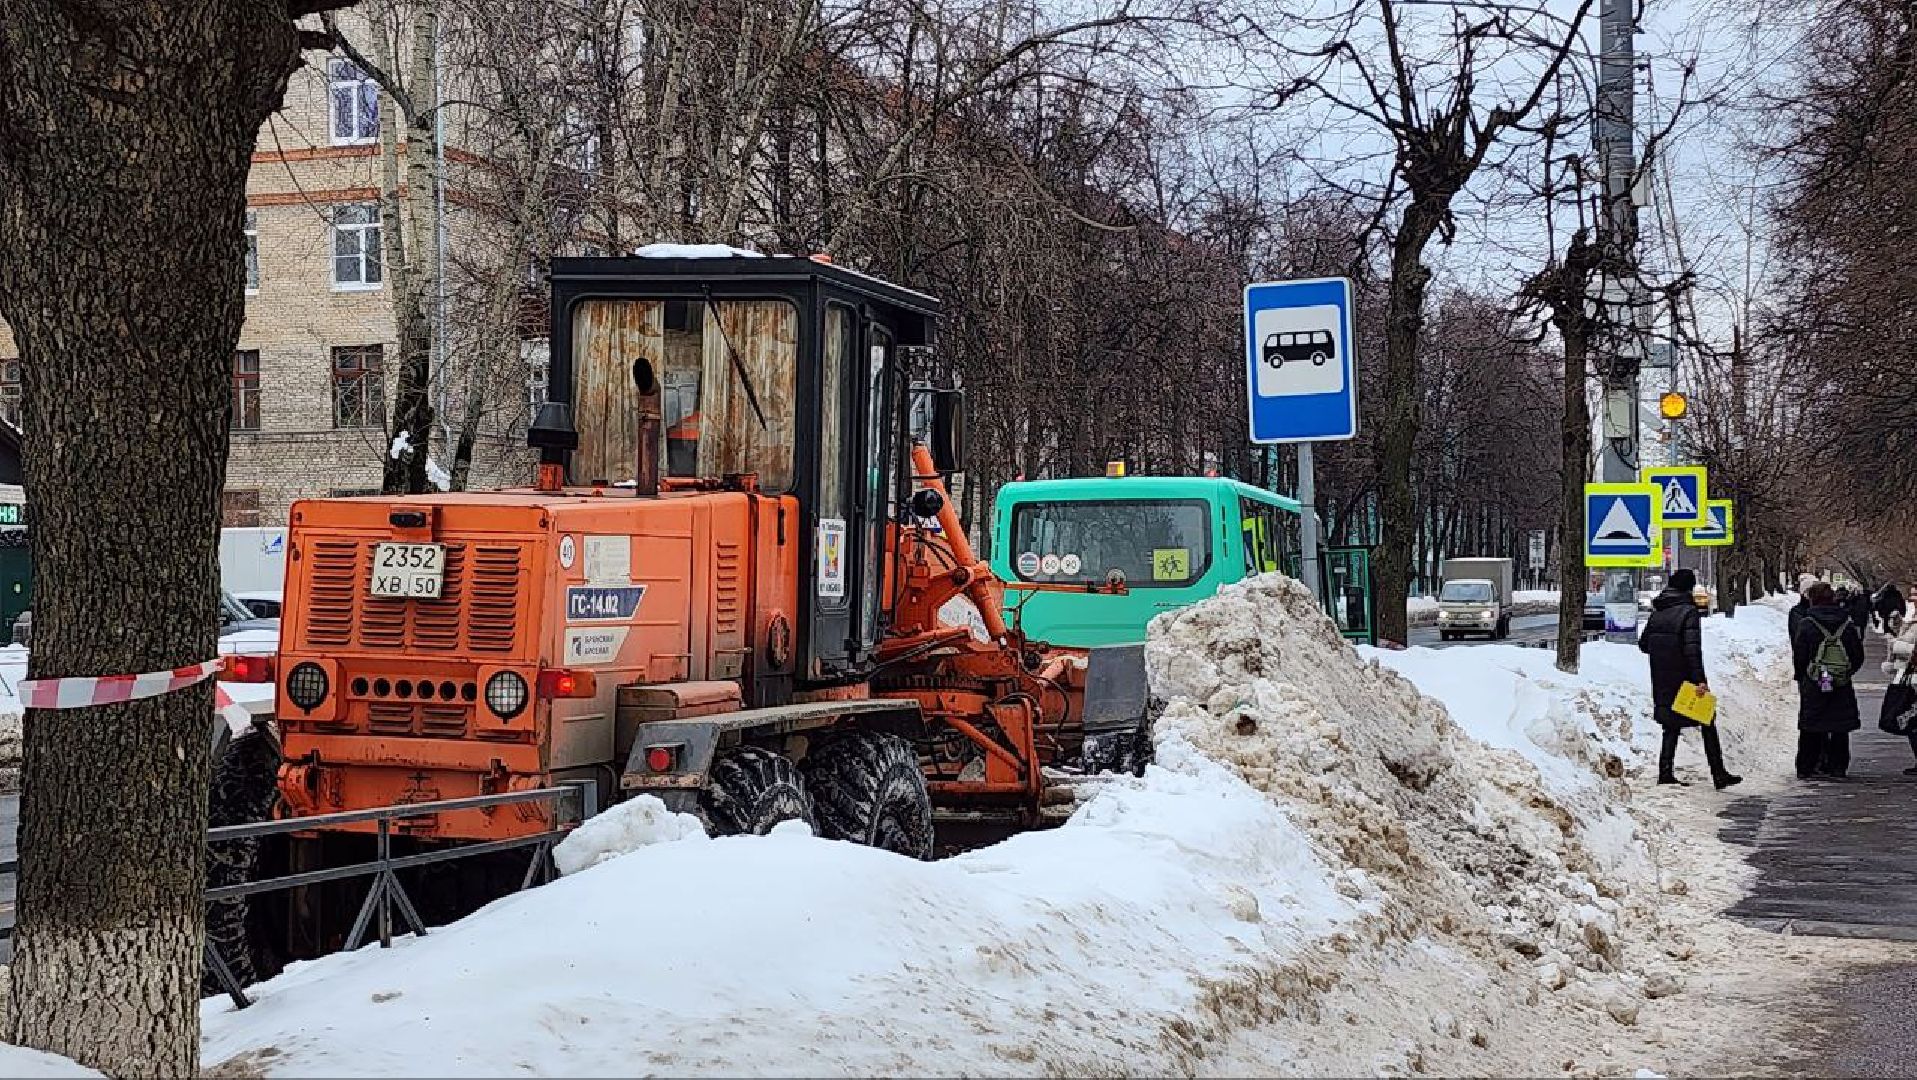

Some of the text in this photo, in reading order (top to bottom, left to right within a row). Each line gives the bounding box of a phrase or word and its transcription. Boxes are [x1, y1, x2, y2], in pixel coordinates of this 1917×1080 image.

[382, 545, 436, 569] 2352
[562, 543, 573, 561] 40
[1045, 559, 1056, 570] 60
[1066, 559, 1077, 570] 90
[376, 575, 436, 594] ХВ 50
[571, 593, 619, 616] ГС-14.02
